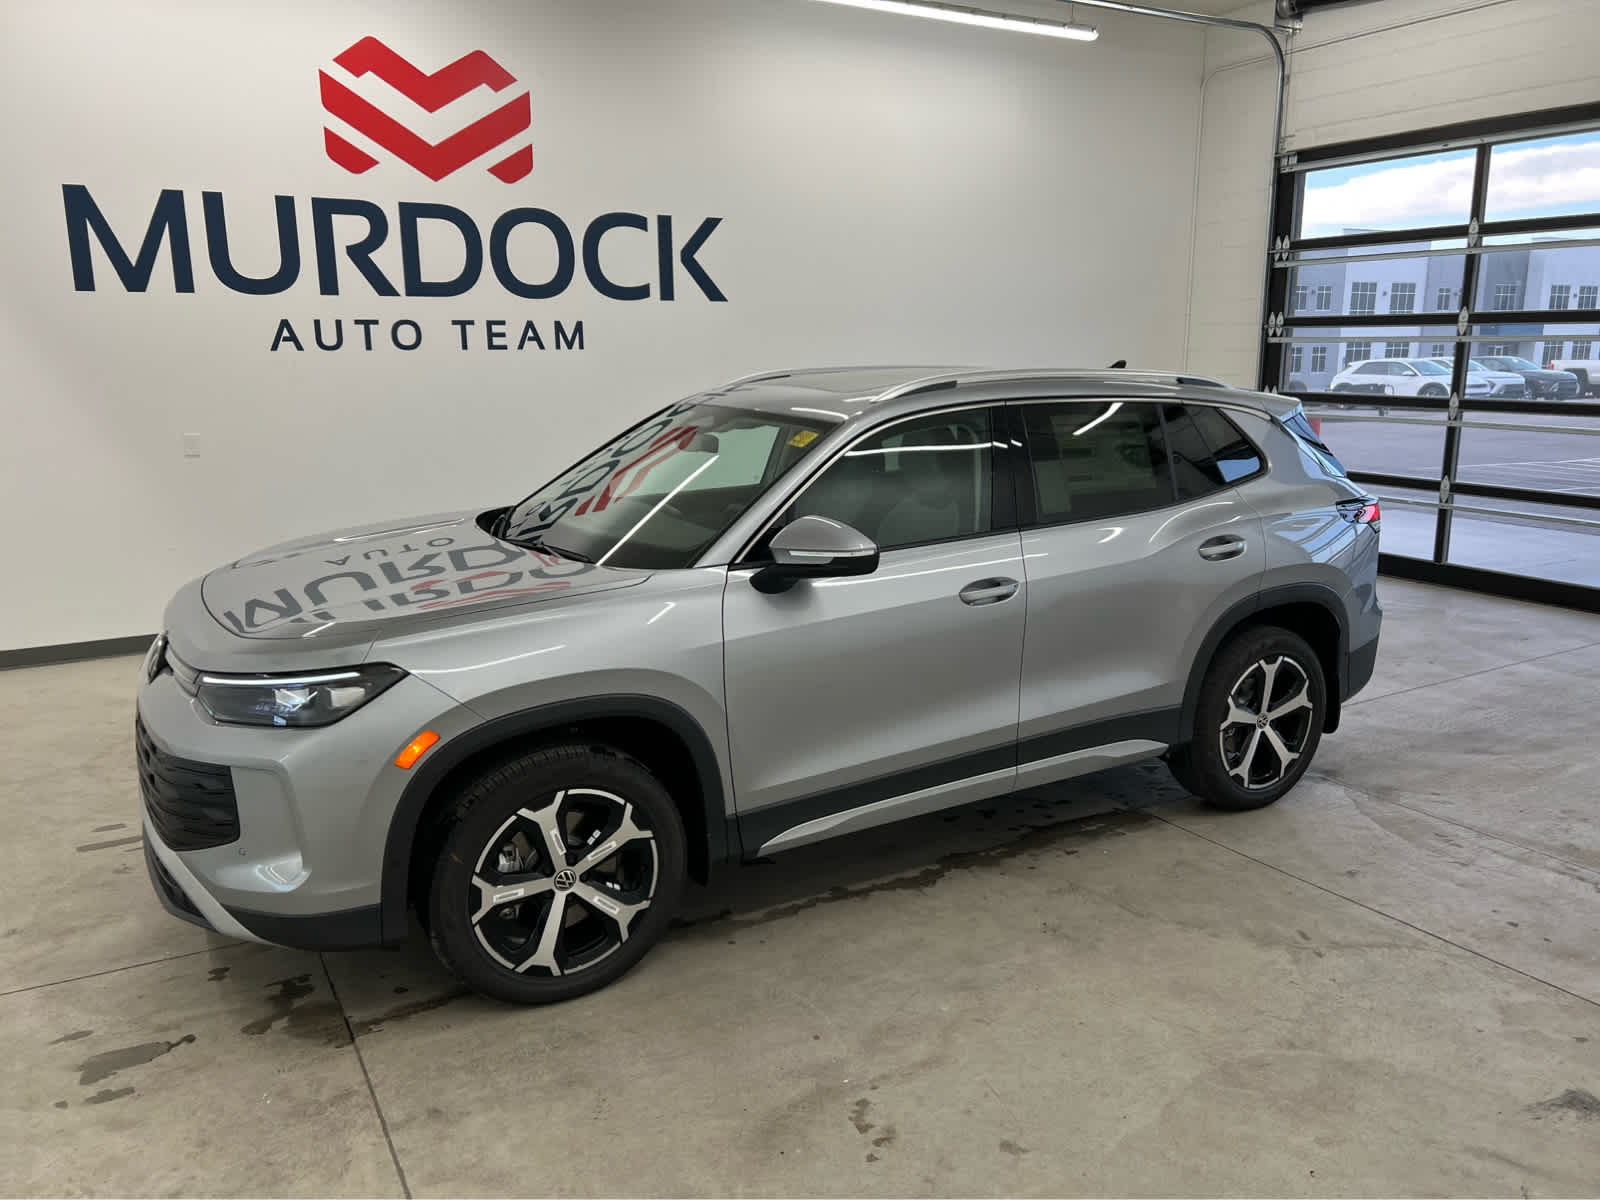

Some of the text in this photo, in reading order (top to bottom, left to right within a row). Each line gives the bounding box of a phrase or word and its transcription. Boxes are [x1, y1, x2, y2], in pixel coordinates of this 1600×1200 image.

[62, 184, 728, 302] MURDOCK
[271, 319, 585, 352] AUTO TEAM
